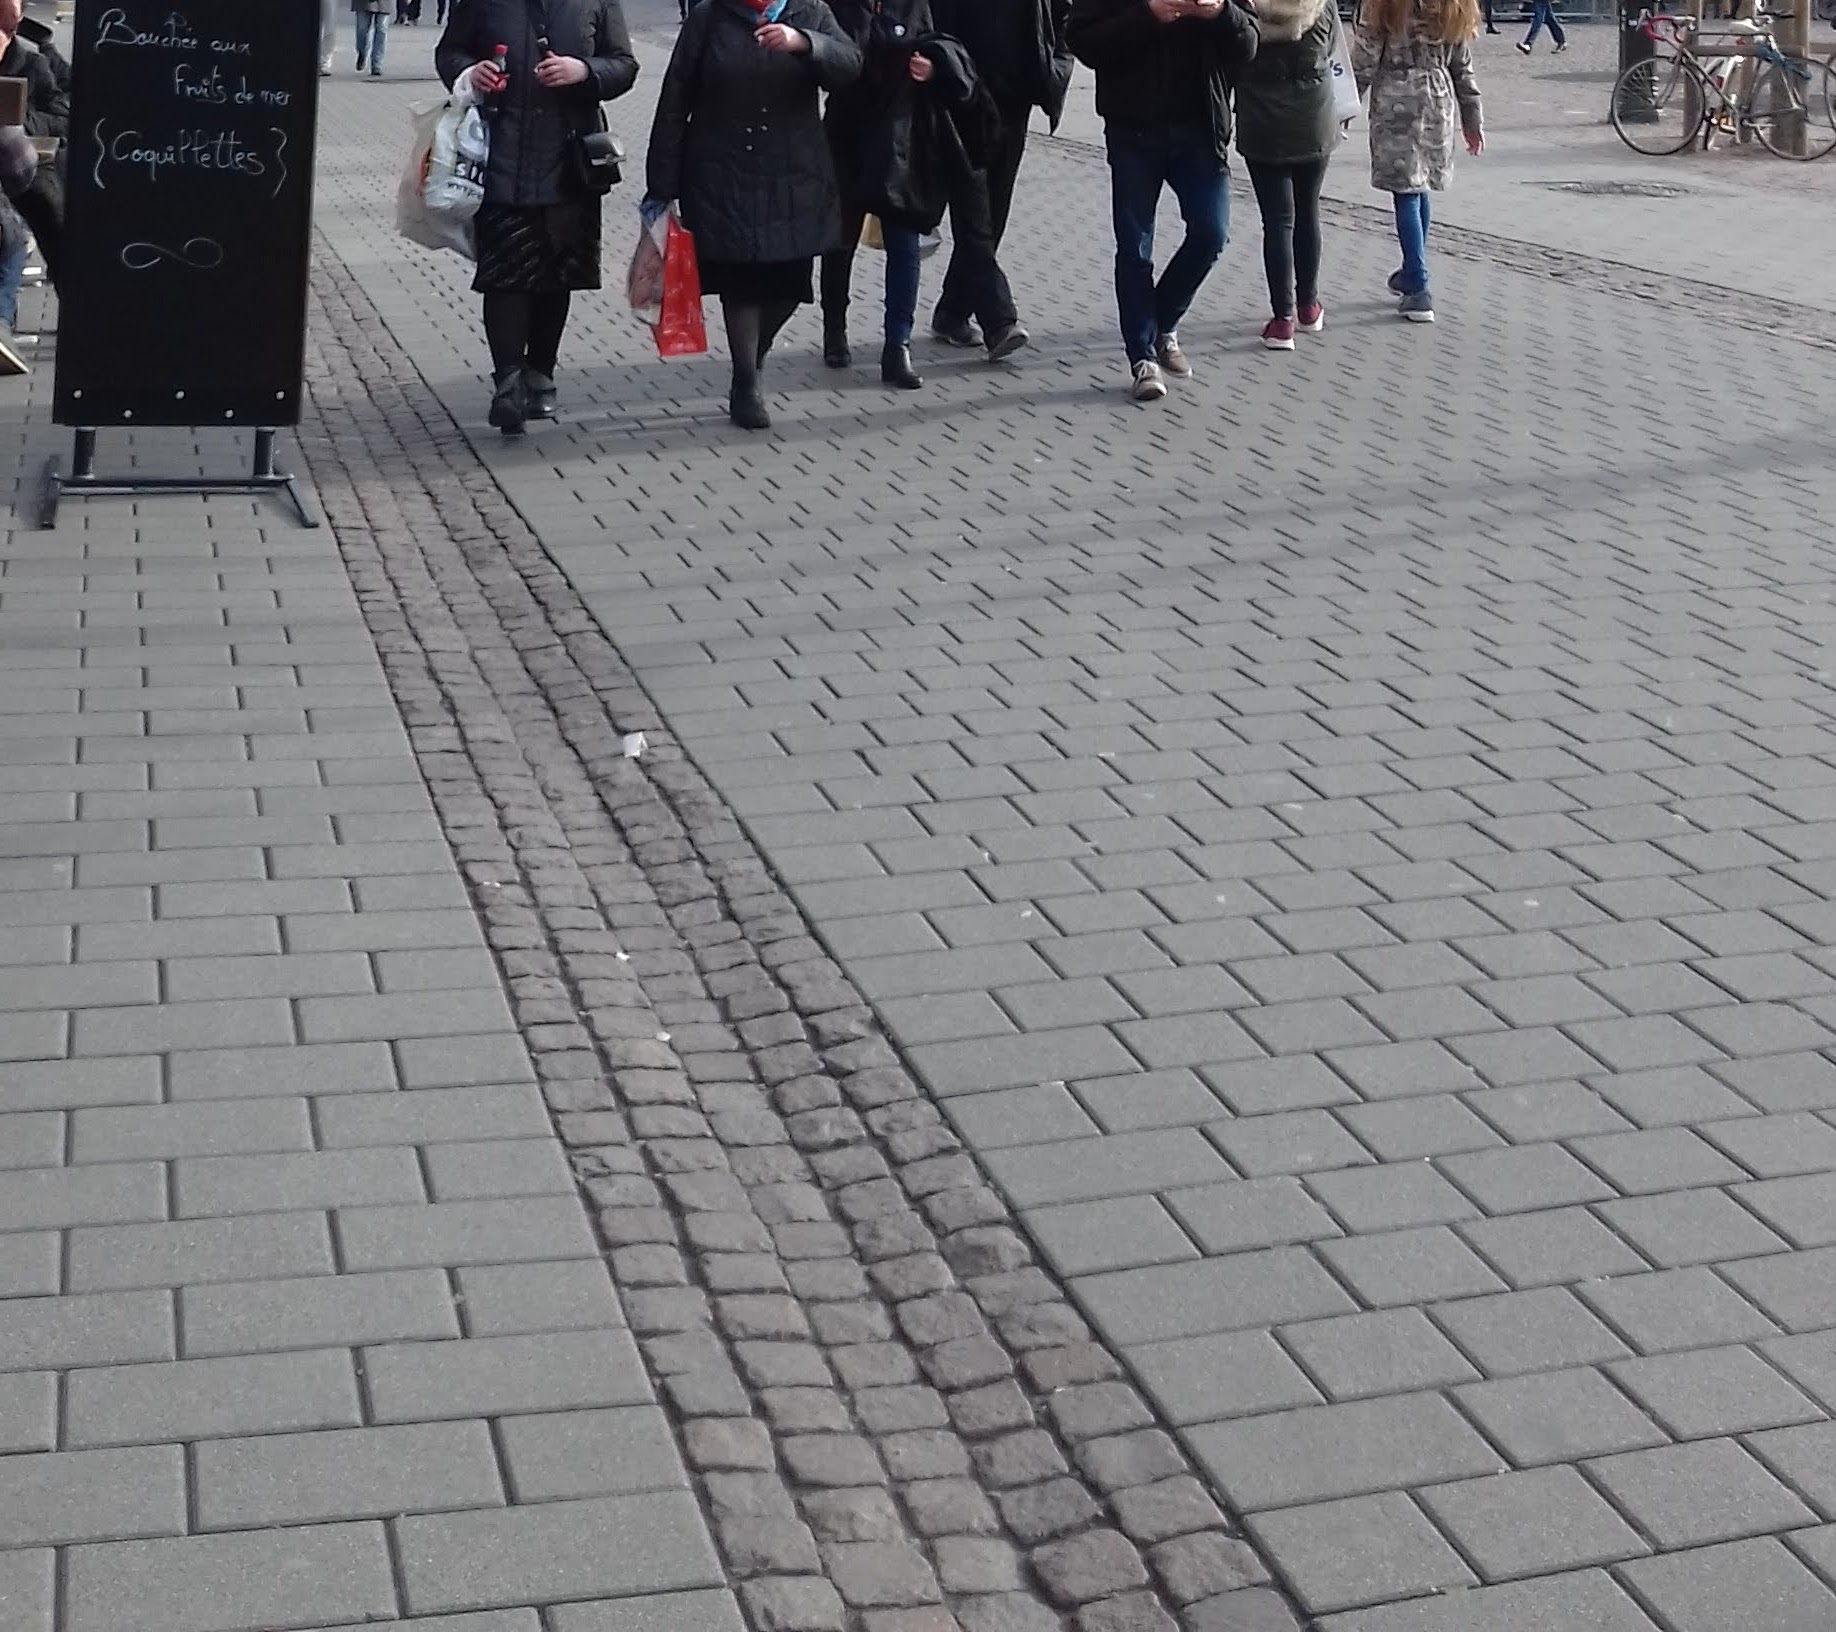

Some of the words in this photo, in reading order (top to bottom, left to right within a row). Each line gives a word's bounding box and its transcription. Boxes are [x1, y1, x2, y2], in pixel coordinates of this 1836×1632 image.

[210, 40, 251, 55] aux
[235, 76, 255, 104] de
[260, 89, 291, 106] mer
